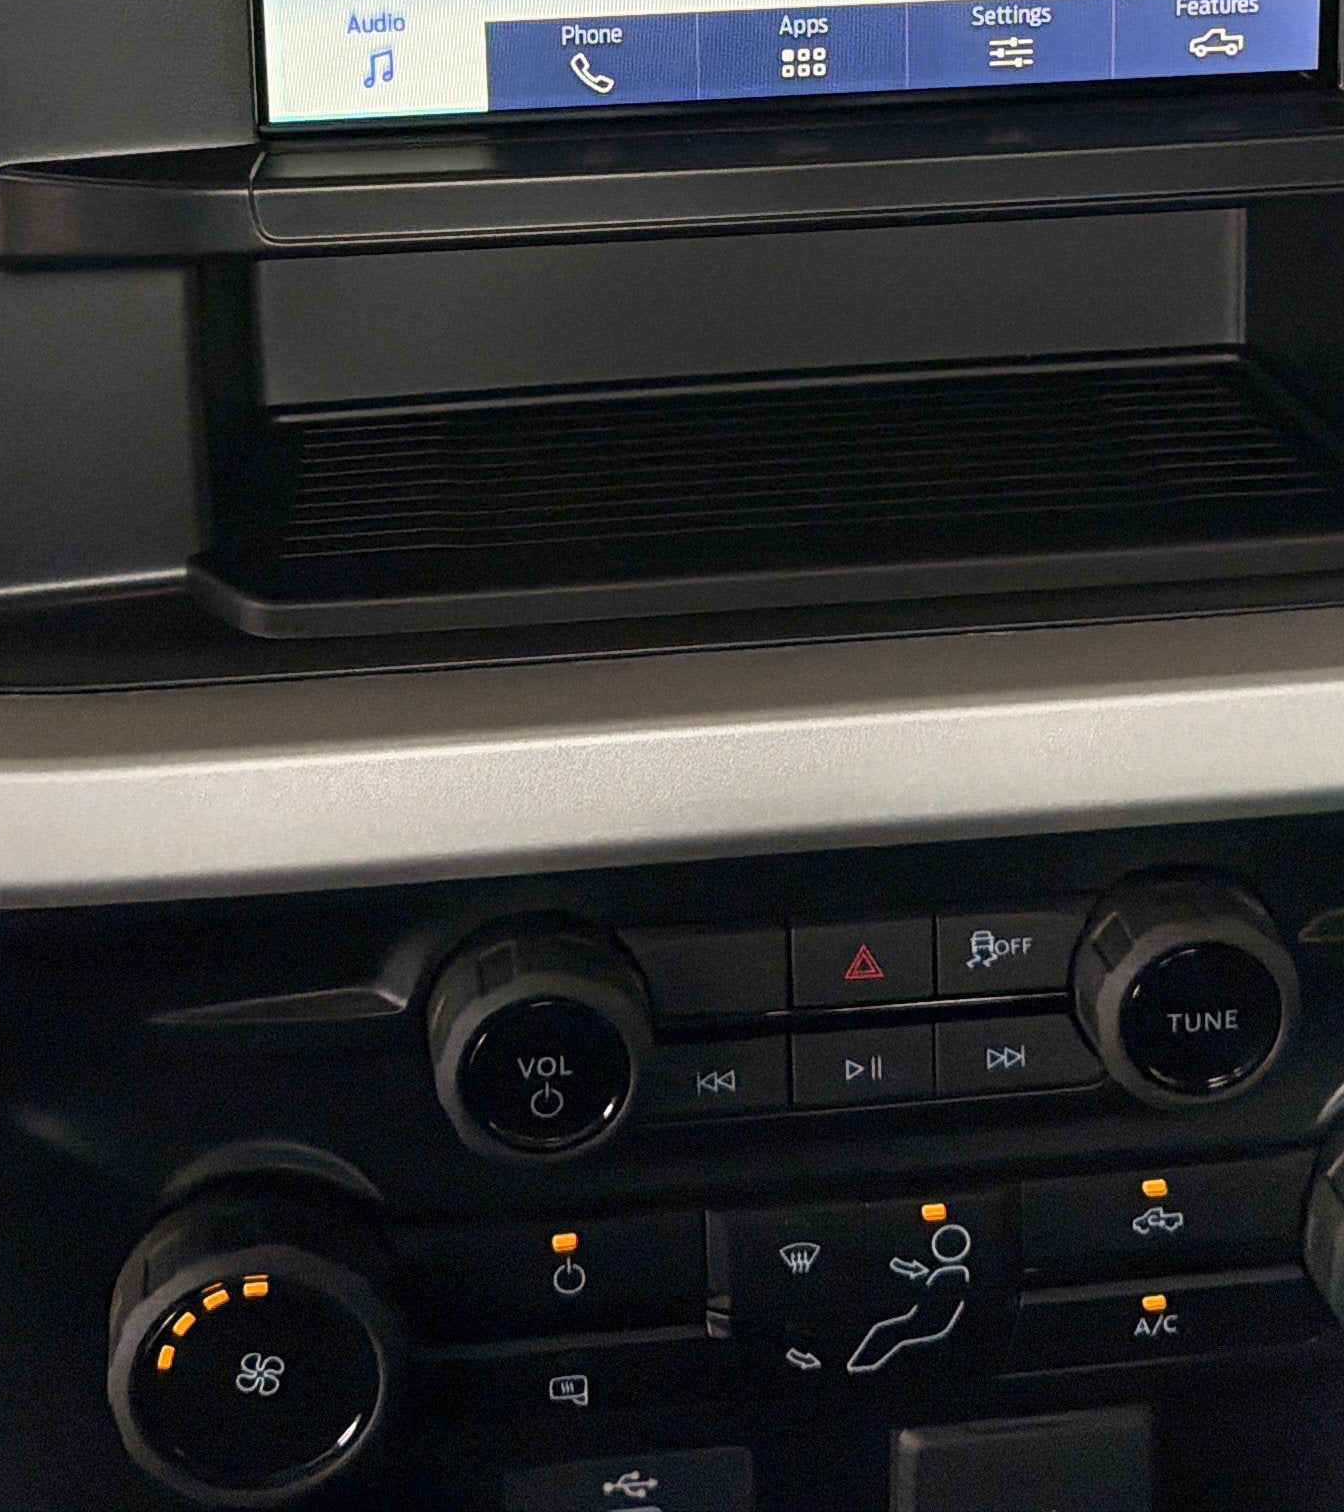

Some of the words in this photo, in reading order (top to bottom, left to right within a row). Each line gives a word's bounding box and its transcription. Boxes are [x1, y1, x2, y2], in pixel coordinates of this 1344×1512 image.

[347, 12, 406, 34] Audio
[561, 24, 623, 47] Phone
[779, 15, 829, 37] Apps
[971, 5, 1052, 27] Settings
[994, 936, 1033, 958] OFF
[1166, 1009, 1239, 1033] TUNE
[517, 1055, 573, 1080] VOL
[1133, 1314, 1179, 1337] A/C
